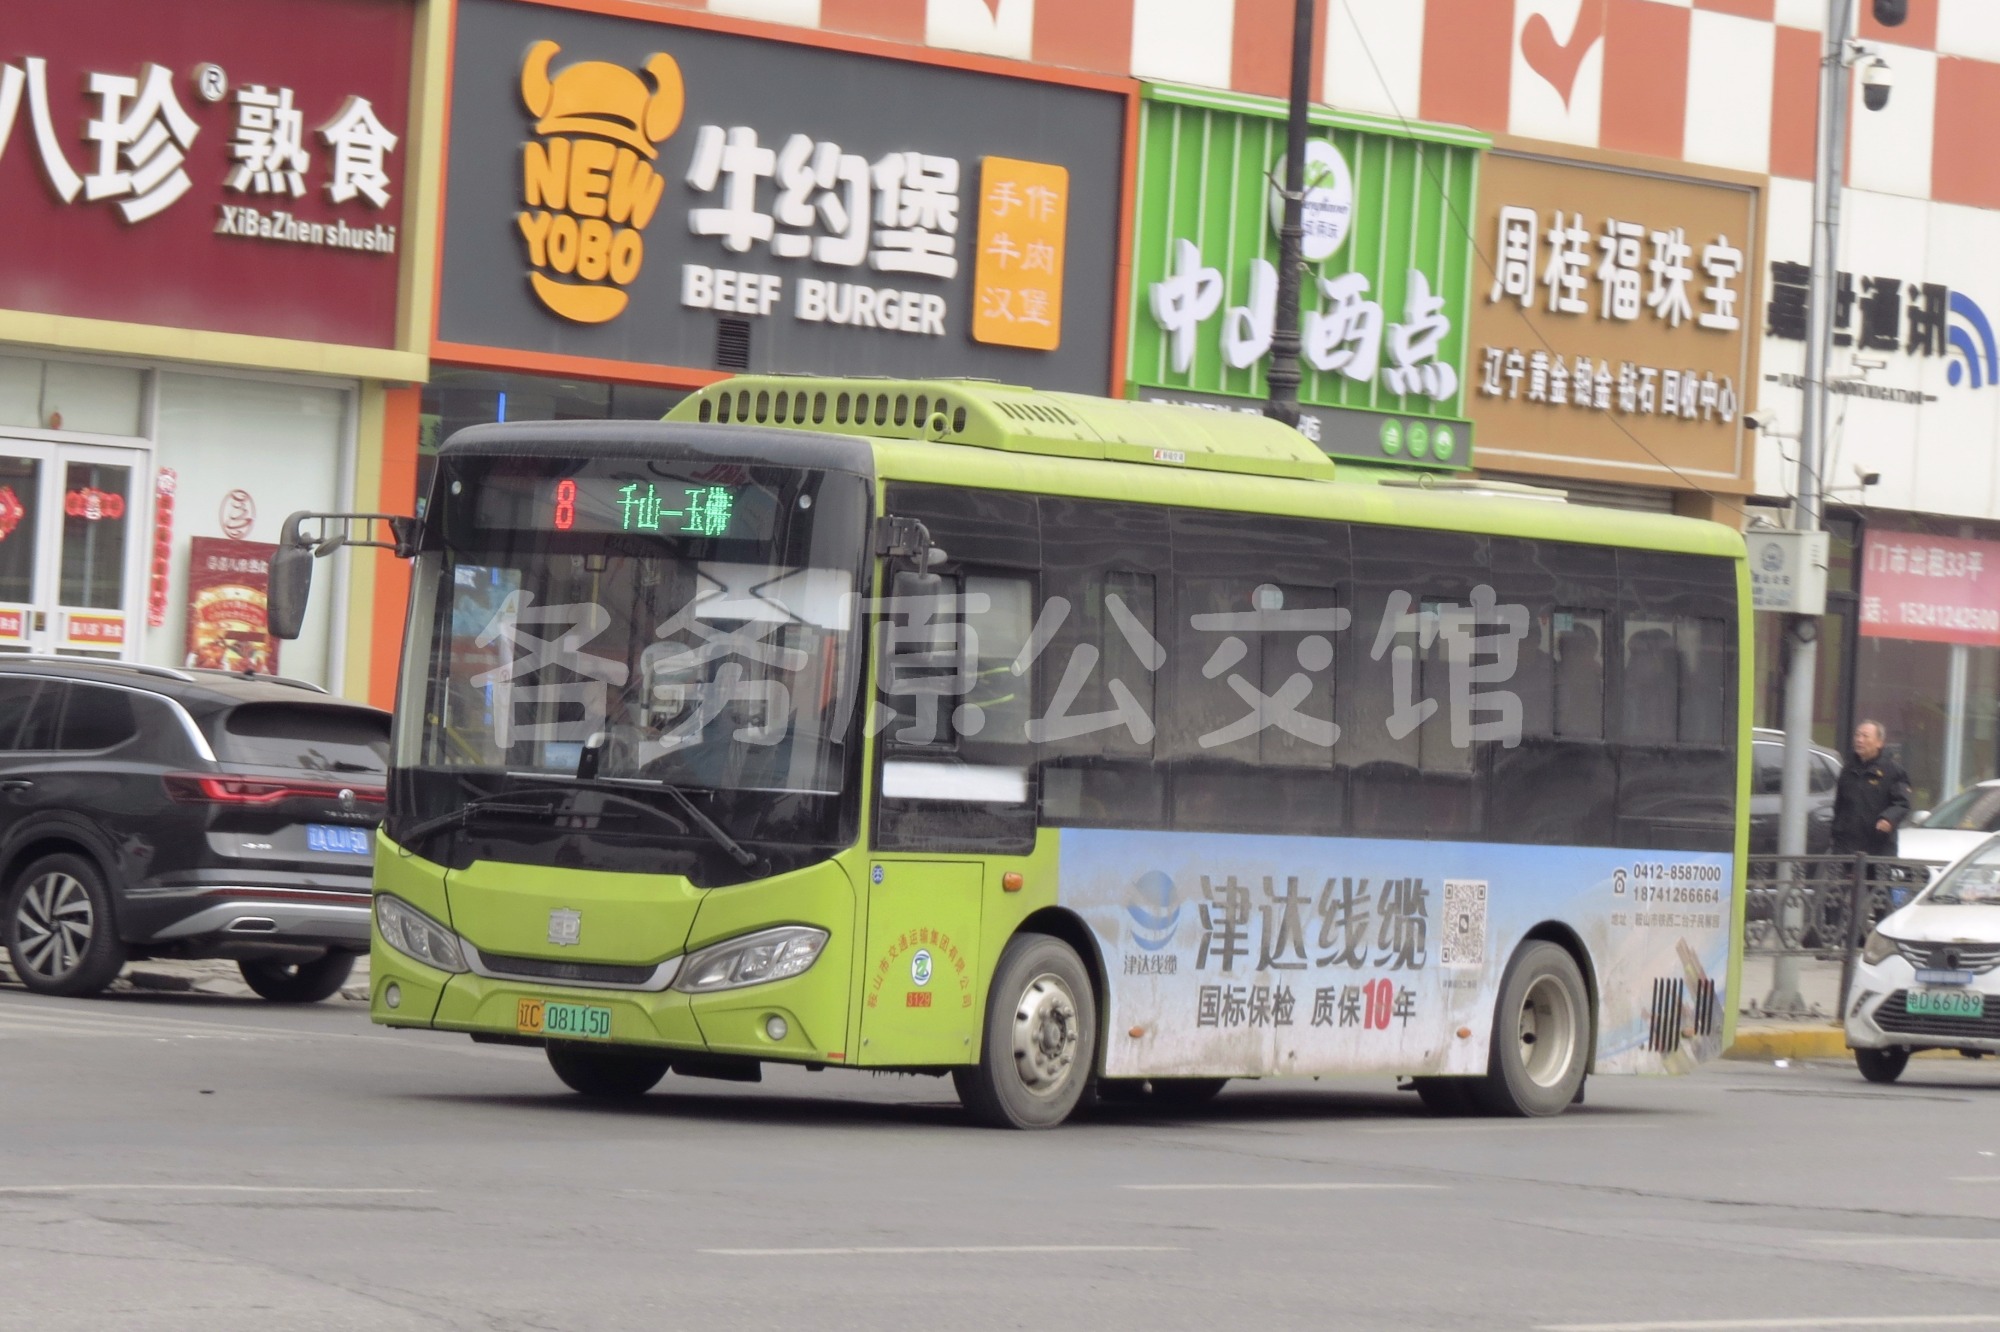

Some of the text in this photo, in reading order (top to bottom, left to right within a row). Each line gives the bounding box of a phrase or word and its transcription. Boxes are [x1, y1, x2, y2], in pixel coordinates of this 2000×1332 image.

[227, 84, 397, 208] 熟食
[523, 138, 664, 230] NEW
[687, 125, 959, 279] 牛约堡
[988, 181, 1058, 222] 手作
[215, 204, 395, 254] XiBaZhen shushi
[517, 211, 643, 286] YOBO
[986, 232, 1055, 276] 牛肉
[1490, 205, 1743, 331] 周桂福珠宝
[681, 264, 946, 336] BEEF BURGER
[982, 287, 1051, 327] 汉堡
[555, 479, 576, 529] 8
[1633, 863, 1721, 882] 0412-8587000
[1633, 886, 1720, 903] 18741266664
[1195, 875, 1430, 971] 津达线缆
[1122, 953, 1178, 976] 津达线缆
[1196, 977, 1417, 1031] 国标保检 质保10年
